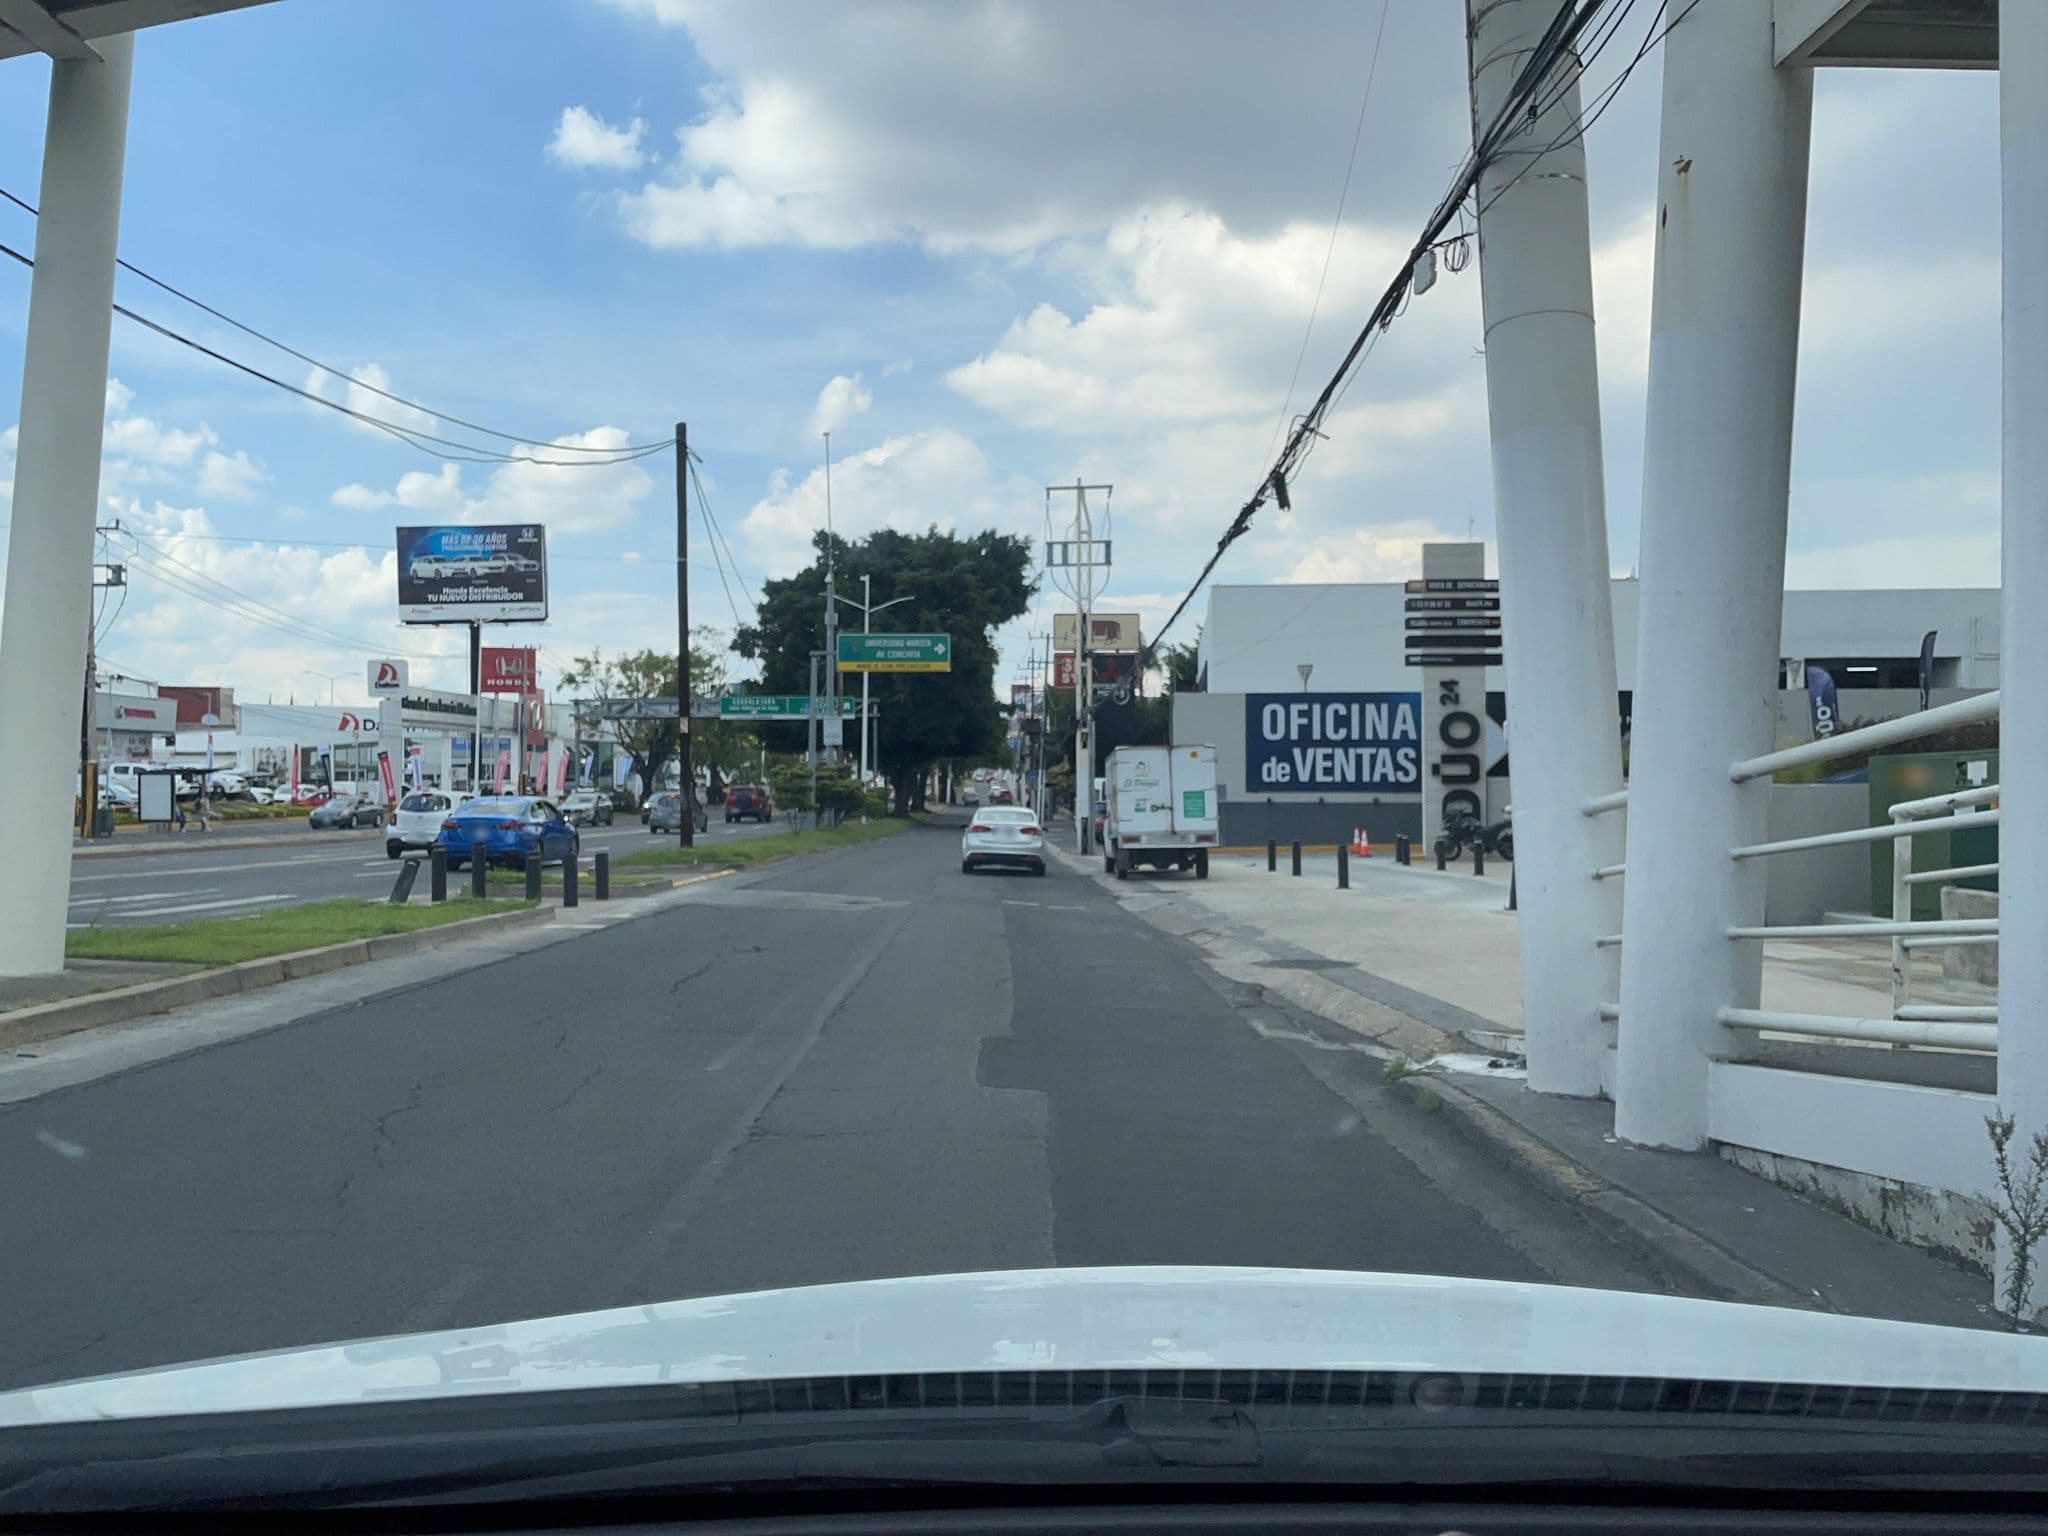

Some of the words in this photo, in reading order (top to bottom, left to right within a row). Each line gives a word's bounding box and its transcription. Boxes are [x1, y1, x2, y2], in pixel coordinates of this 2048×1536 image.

[441, 533, 458, 545] MÁS
[485, 532, 508, 544] AÑOS
[443, 587, 468, 595] Honda
[469, 586, 508, 594] Excelencia
[428, 593, 438, 603] TU
[440, 593, 467, 603] NUEVO
[469, 592, 524, 602] DISTRIBUIDOR
[374, 682, 400, 690] Dalton
[487, 678, 530, 687] HONDA
[1261, 702, 1418, 742] OFICINA
[1261, 756, 1291, 783] de
[1291, 747, 1418, 784] VENTAS
